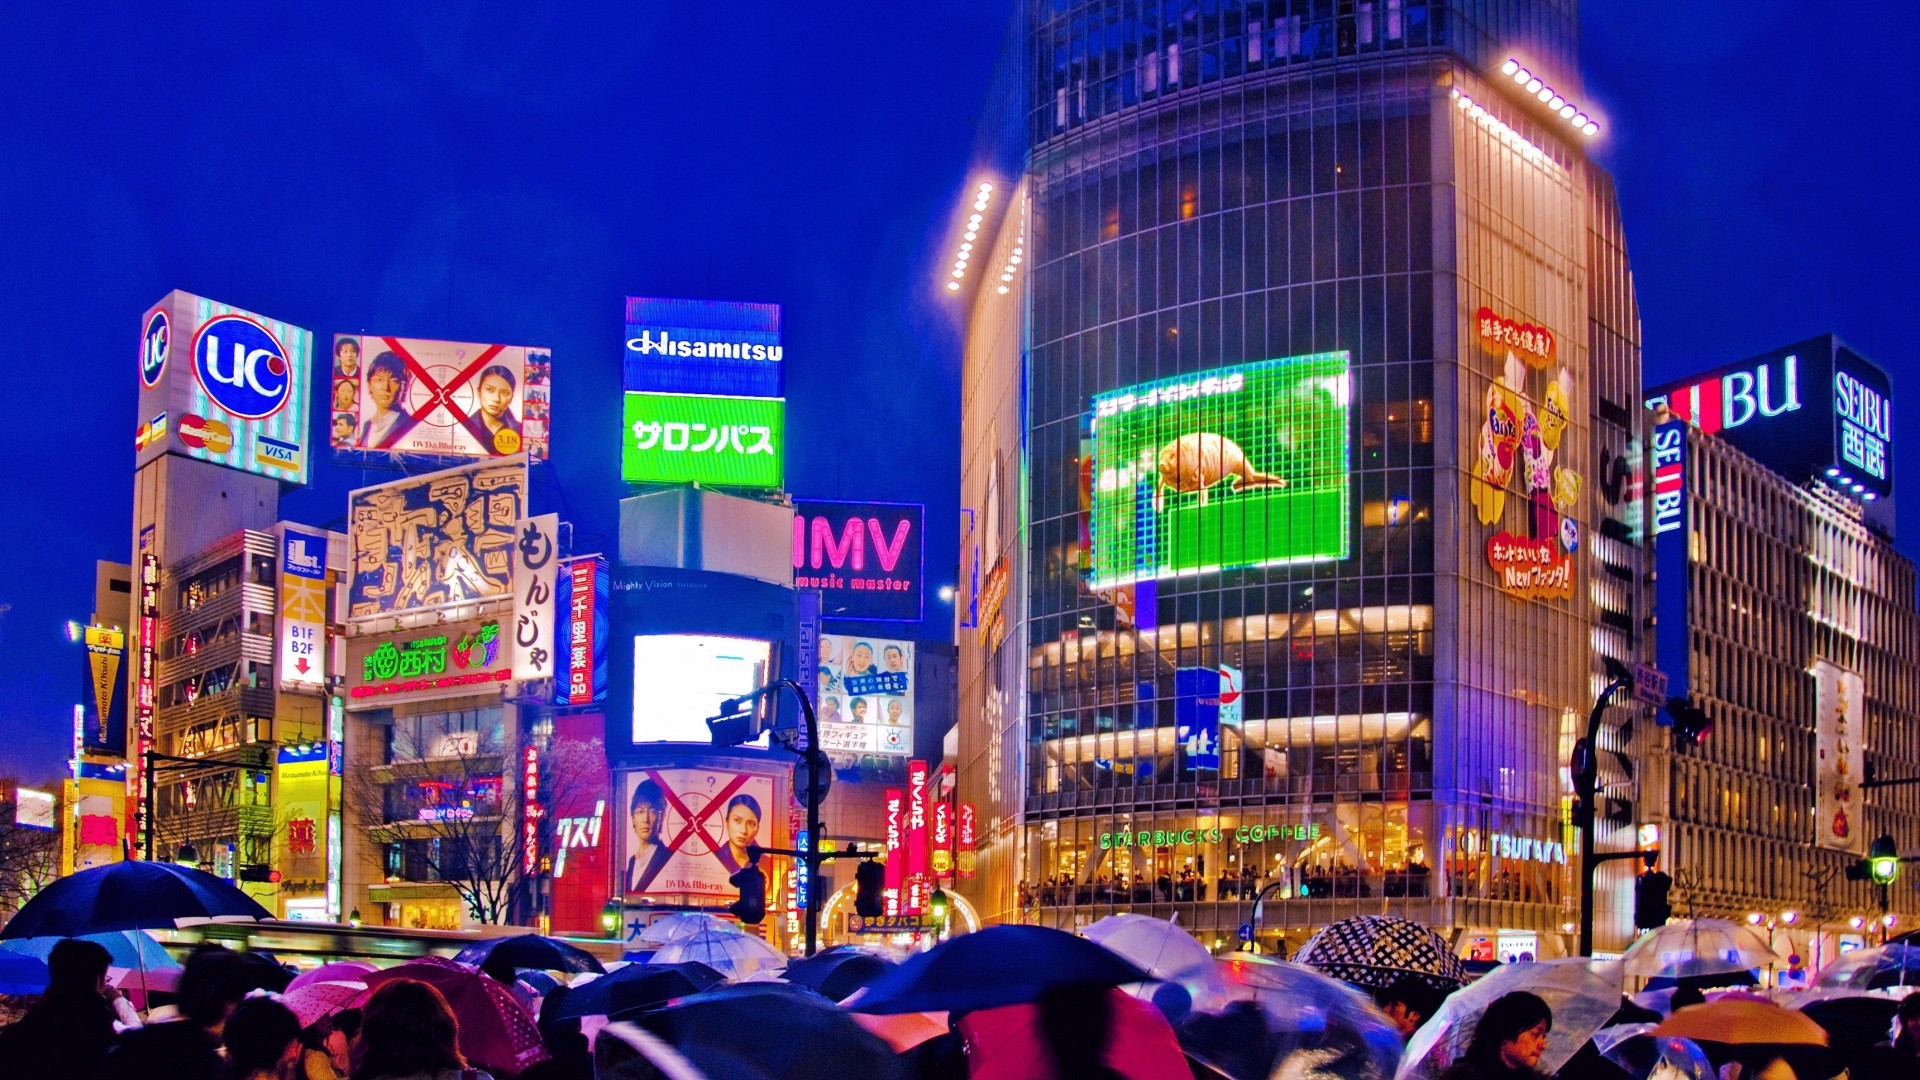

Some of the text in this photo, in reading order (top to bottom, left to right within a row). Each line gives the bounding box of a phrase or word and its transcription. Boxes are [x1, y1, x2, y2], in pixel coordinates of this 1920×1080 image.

[626, 330, 784, 362] Hisamitsu
[206, 335, 282, 397] UC
[1836, 371, 1891, 442] SEIBU
[179, 422, 232, 444] MasterCard
[498, 434, 518, 446] 3.18
[632, 420, 775, 456] サロンパス
[265, 445, 292, 461] VISA
[1842, 419, 1886, 480] 西武
[1655, 428, 1682, 534] SEIBU
[516, 521, 553, 672] もんじゃ
[612, 581, 643, 591] Mighty
[645, 580, 673, 591] Vision
[795, 573, 911, 591] music master
[291, 625, 315, 640] B1F
[570, 567, 588, 695] 三千里薬品
[291, 641, 314, 655] B2F
[400, 647, 447, 677] 西村
[818, 730, 867, 740] 界フィギュア
[818, 739, 867, 749] ケート選手権
[911, 770, 925, 831] さくらや
[887, 798, 900, 852] さくらや
[1100, 823, 1322, 850] STARBUCKS COFFEE
[1491, 833, 1567, 865] TSUTAYA
